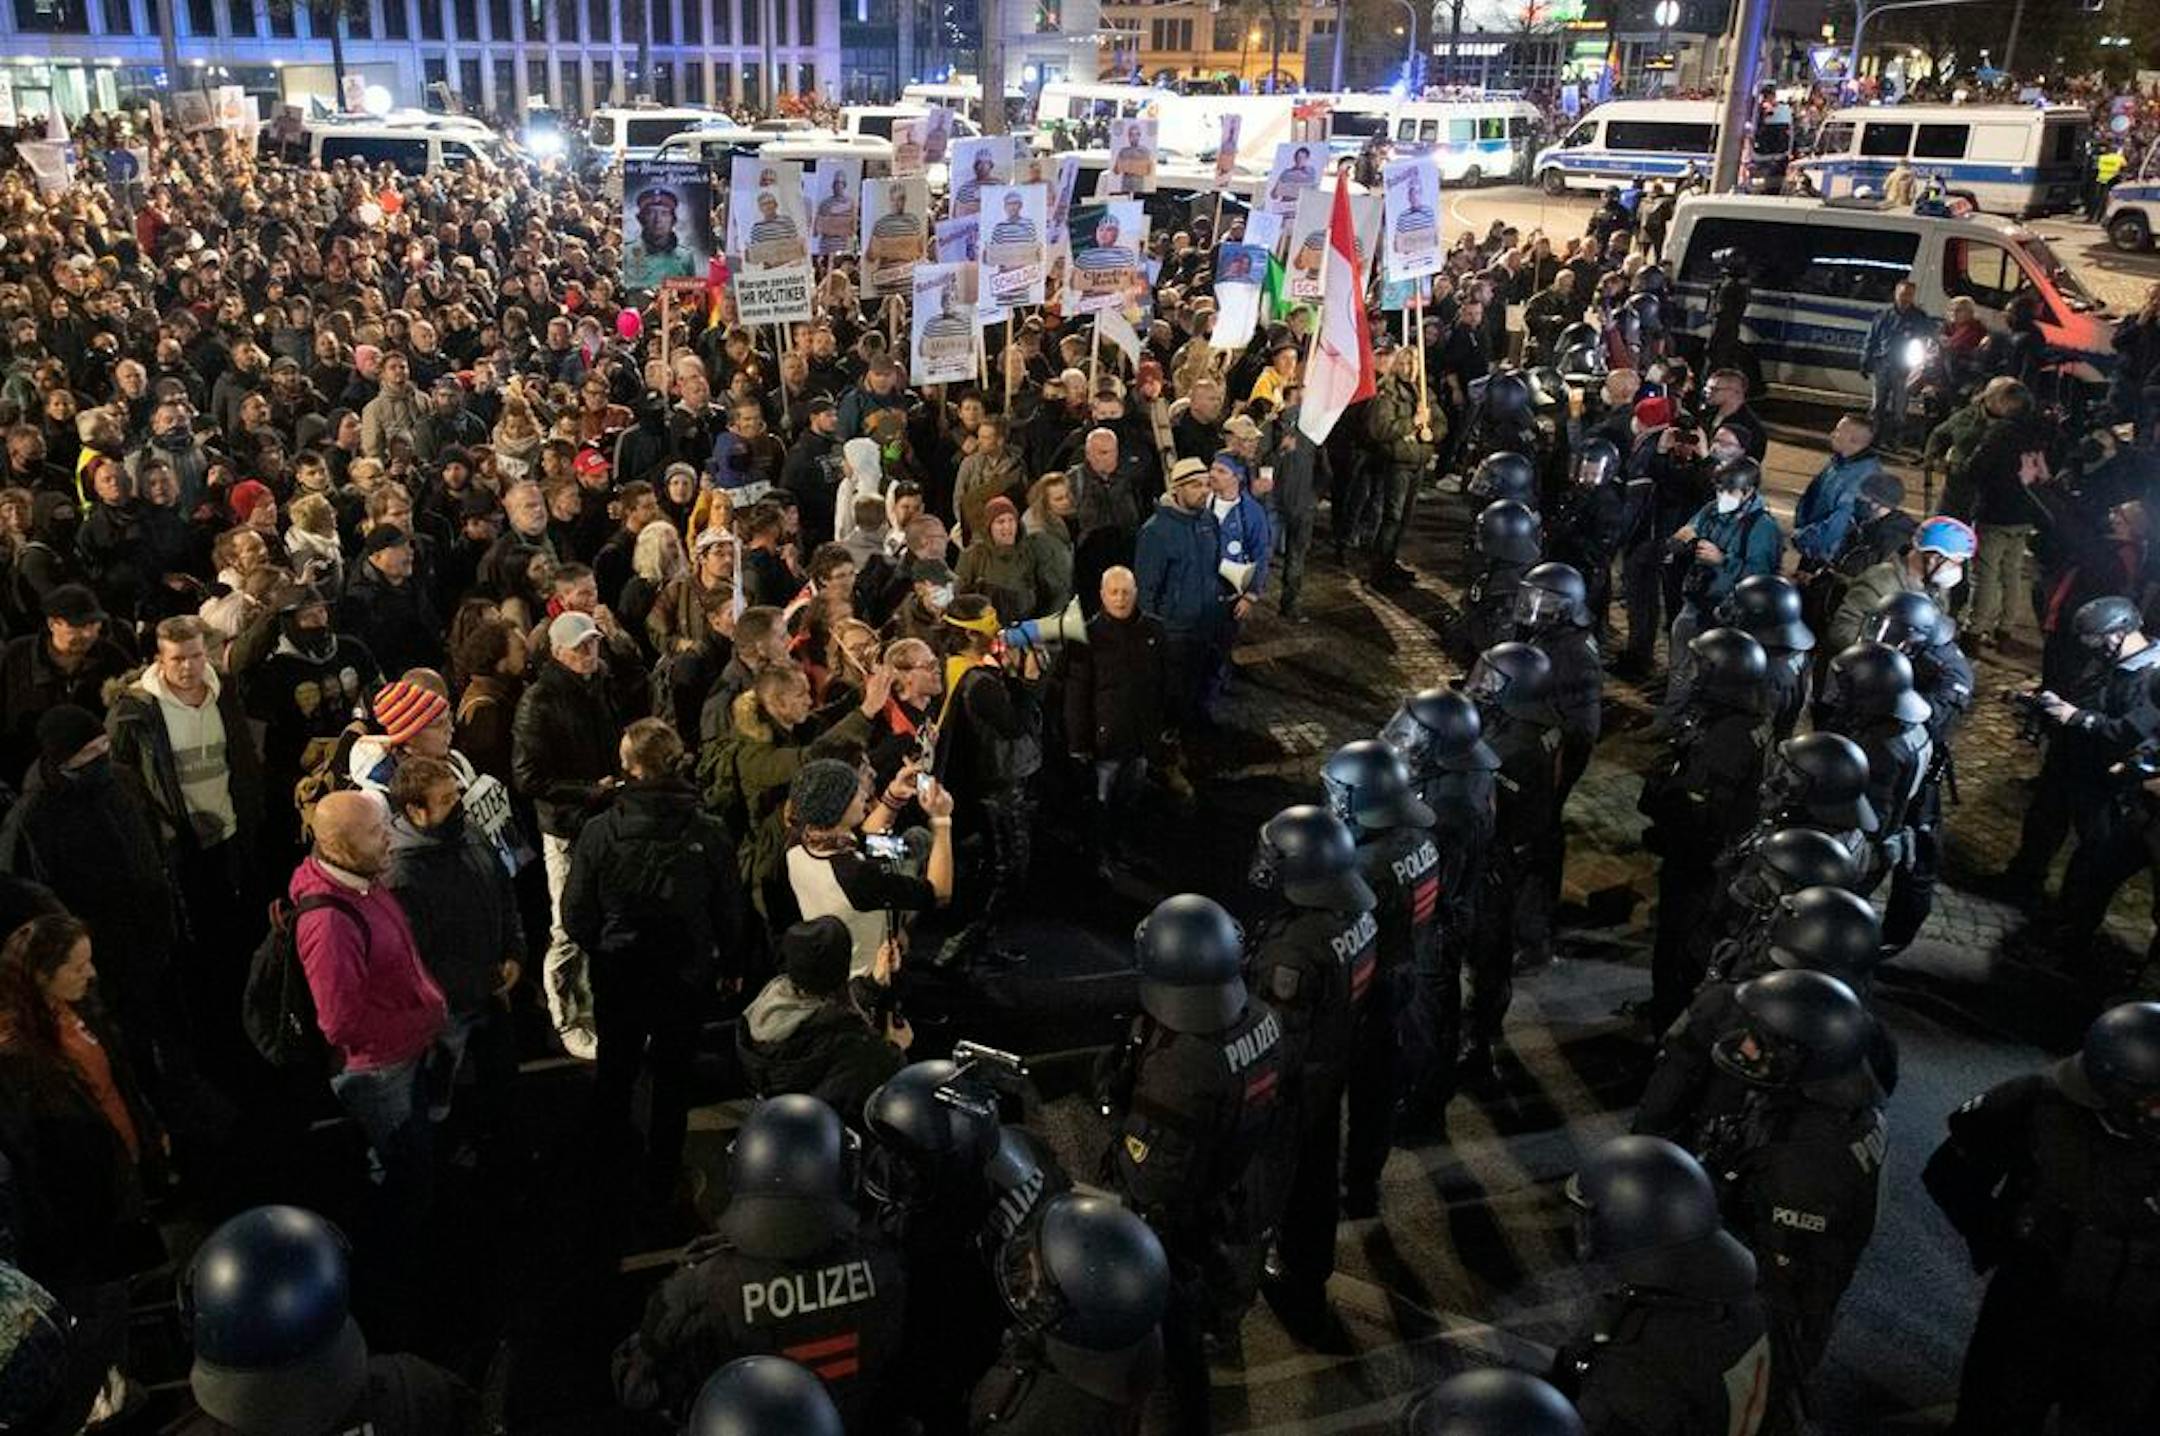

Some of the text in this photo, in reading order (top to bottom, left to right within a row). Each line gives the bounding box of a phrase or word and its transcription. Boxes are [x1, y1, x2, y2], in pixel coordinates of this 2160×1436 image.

[740, 286, 806, 305] IHR POLITIKER
[1772, 1207, 1826, 1232] POLIZEI
[742, 1260, 876, 1323] POLIZEI
